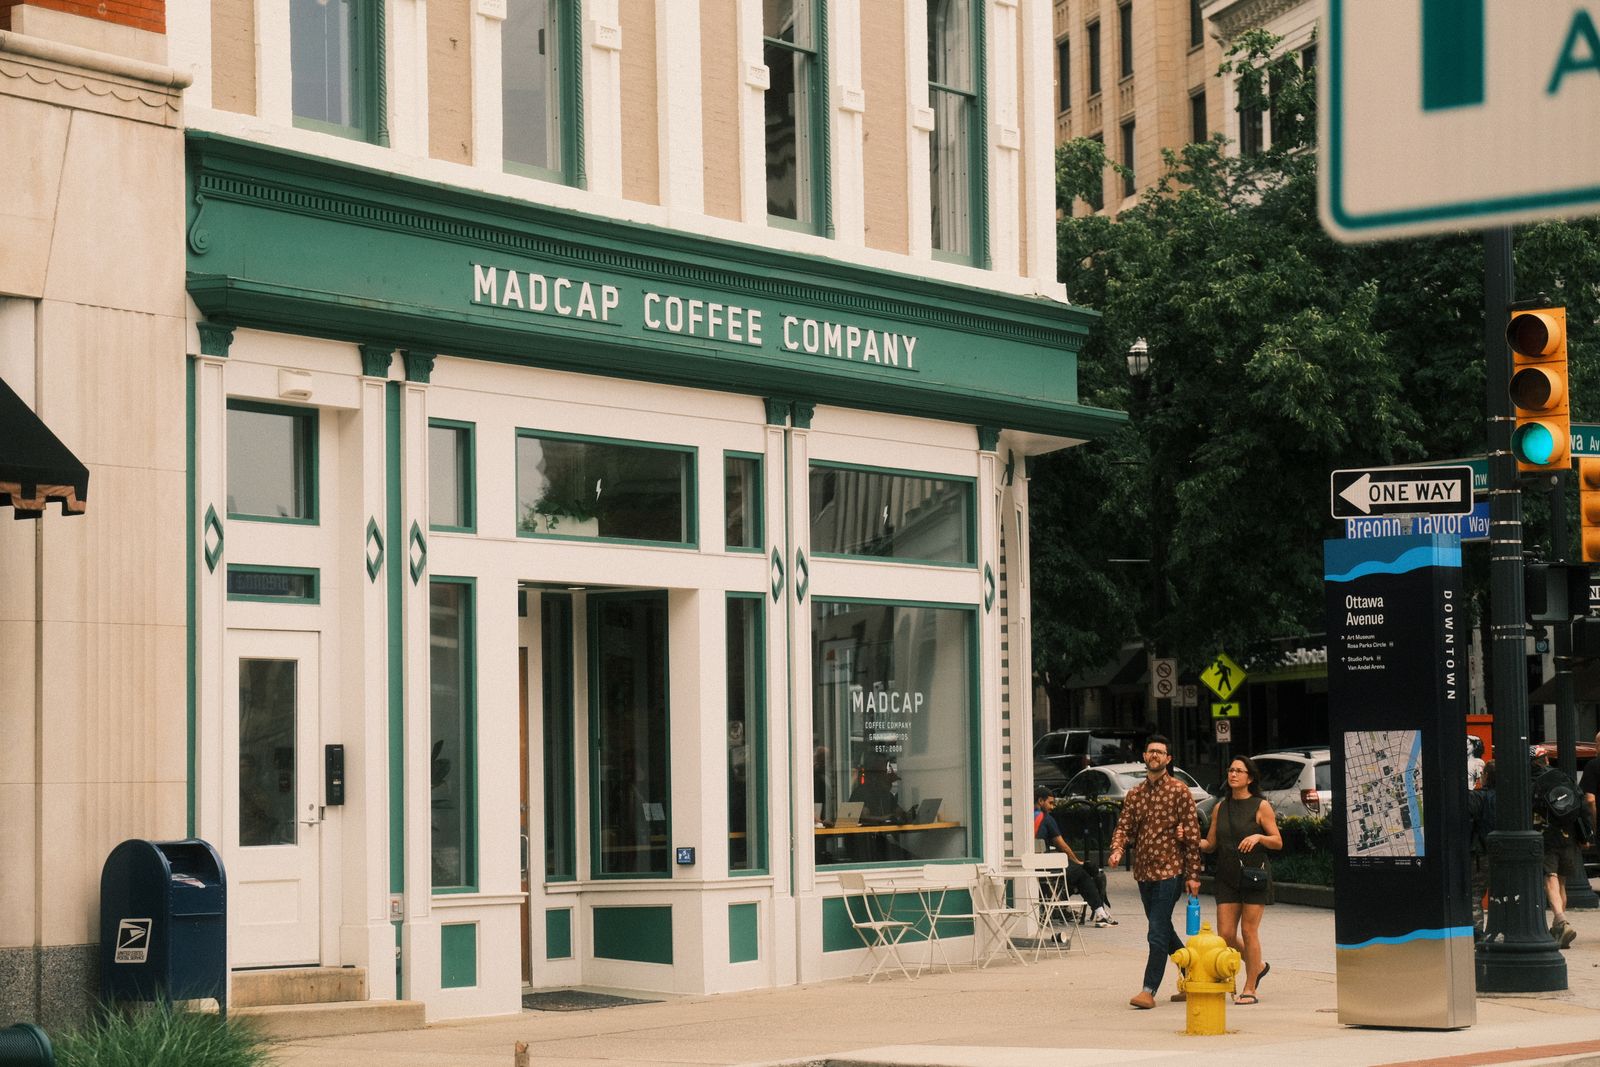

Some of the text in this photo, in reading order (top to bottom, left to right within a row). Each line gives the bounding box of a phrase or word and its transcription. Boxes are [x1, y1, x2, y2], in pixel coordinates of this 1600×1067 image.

[473, 264, 918, 369] MADCAP COFFEE COMPANY
[1369, 482, 1455, 502] ONE WAY
[1347, 518, 1401, 539] Breonn
[1468, 516, 1490, 535] Way
[1346, 595, 1384, 609] Ottawa
[1346, 612, 1384, 626] Avenue
[1443, 590, 1456, 700] DOWNTOWN
[853, 691, 923, 713] MADCAP
